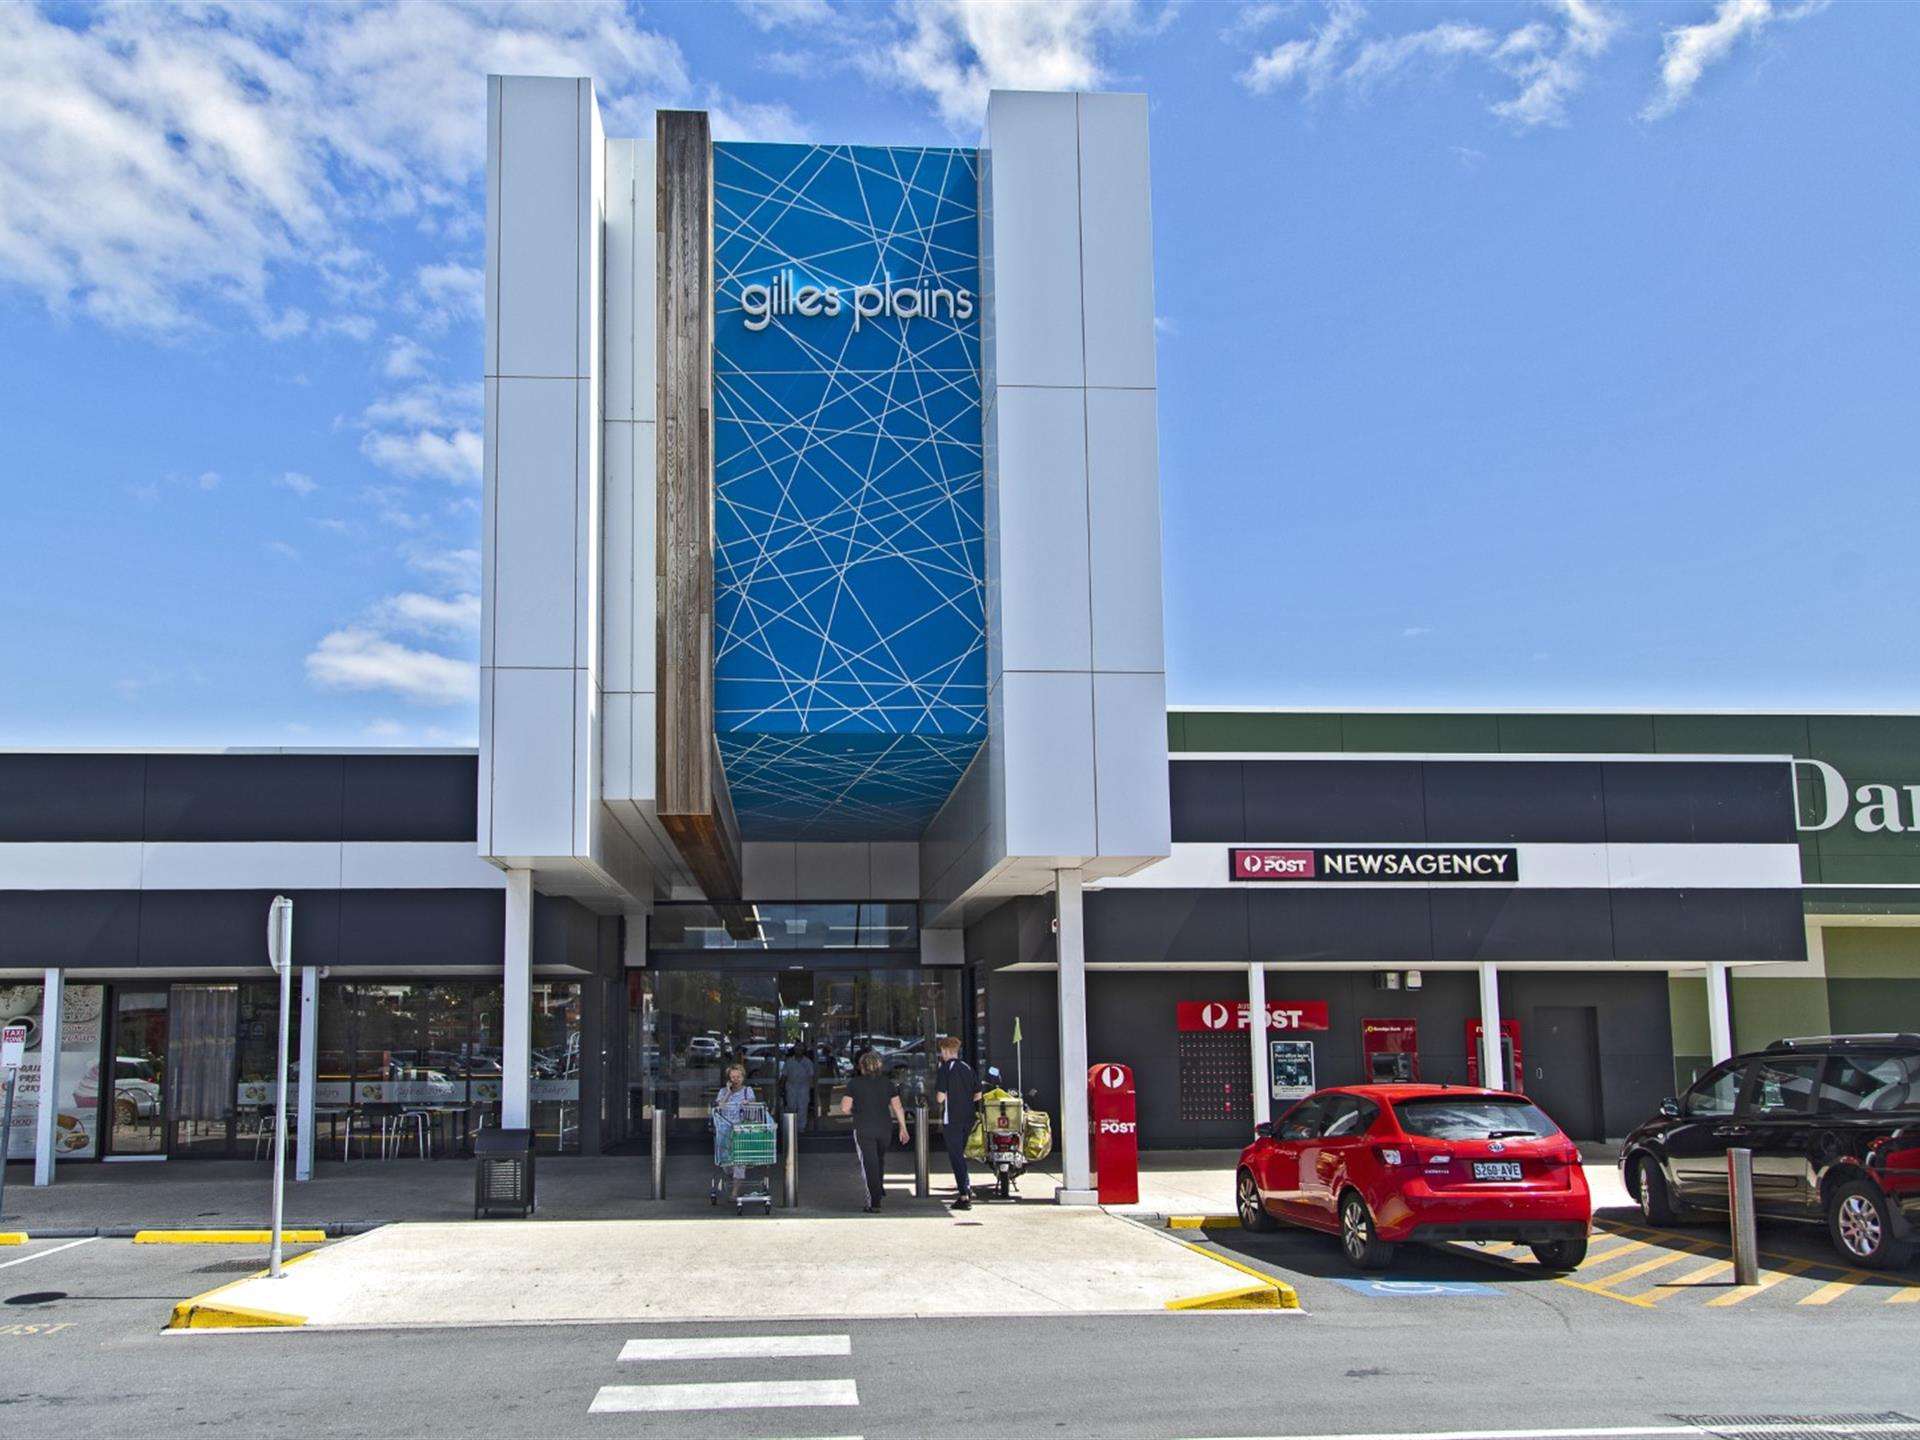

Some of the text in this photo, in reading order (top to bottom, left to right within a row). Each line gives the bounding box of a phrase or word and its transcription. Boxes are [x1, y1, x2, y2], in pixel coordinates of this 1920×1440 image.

[741, 269, 974, 333] gilles plains
[1264, 859, 1307, 873] POST
[1324, 854, 1508, 874] NEWSAGENCY
[1101, 1121, 1136, 1133] POST
